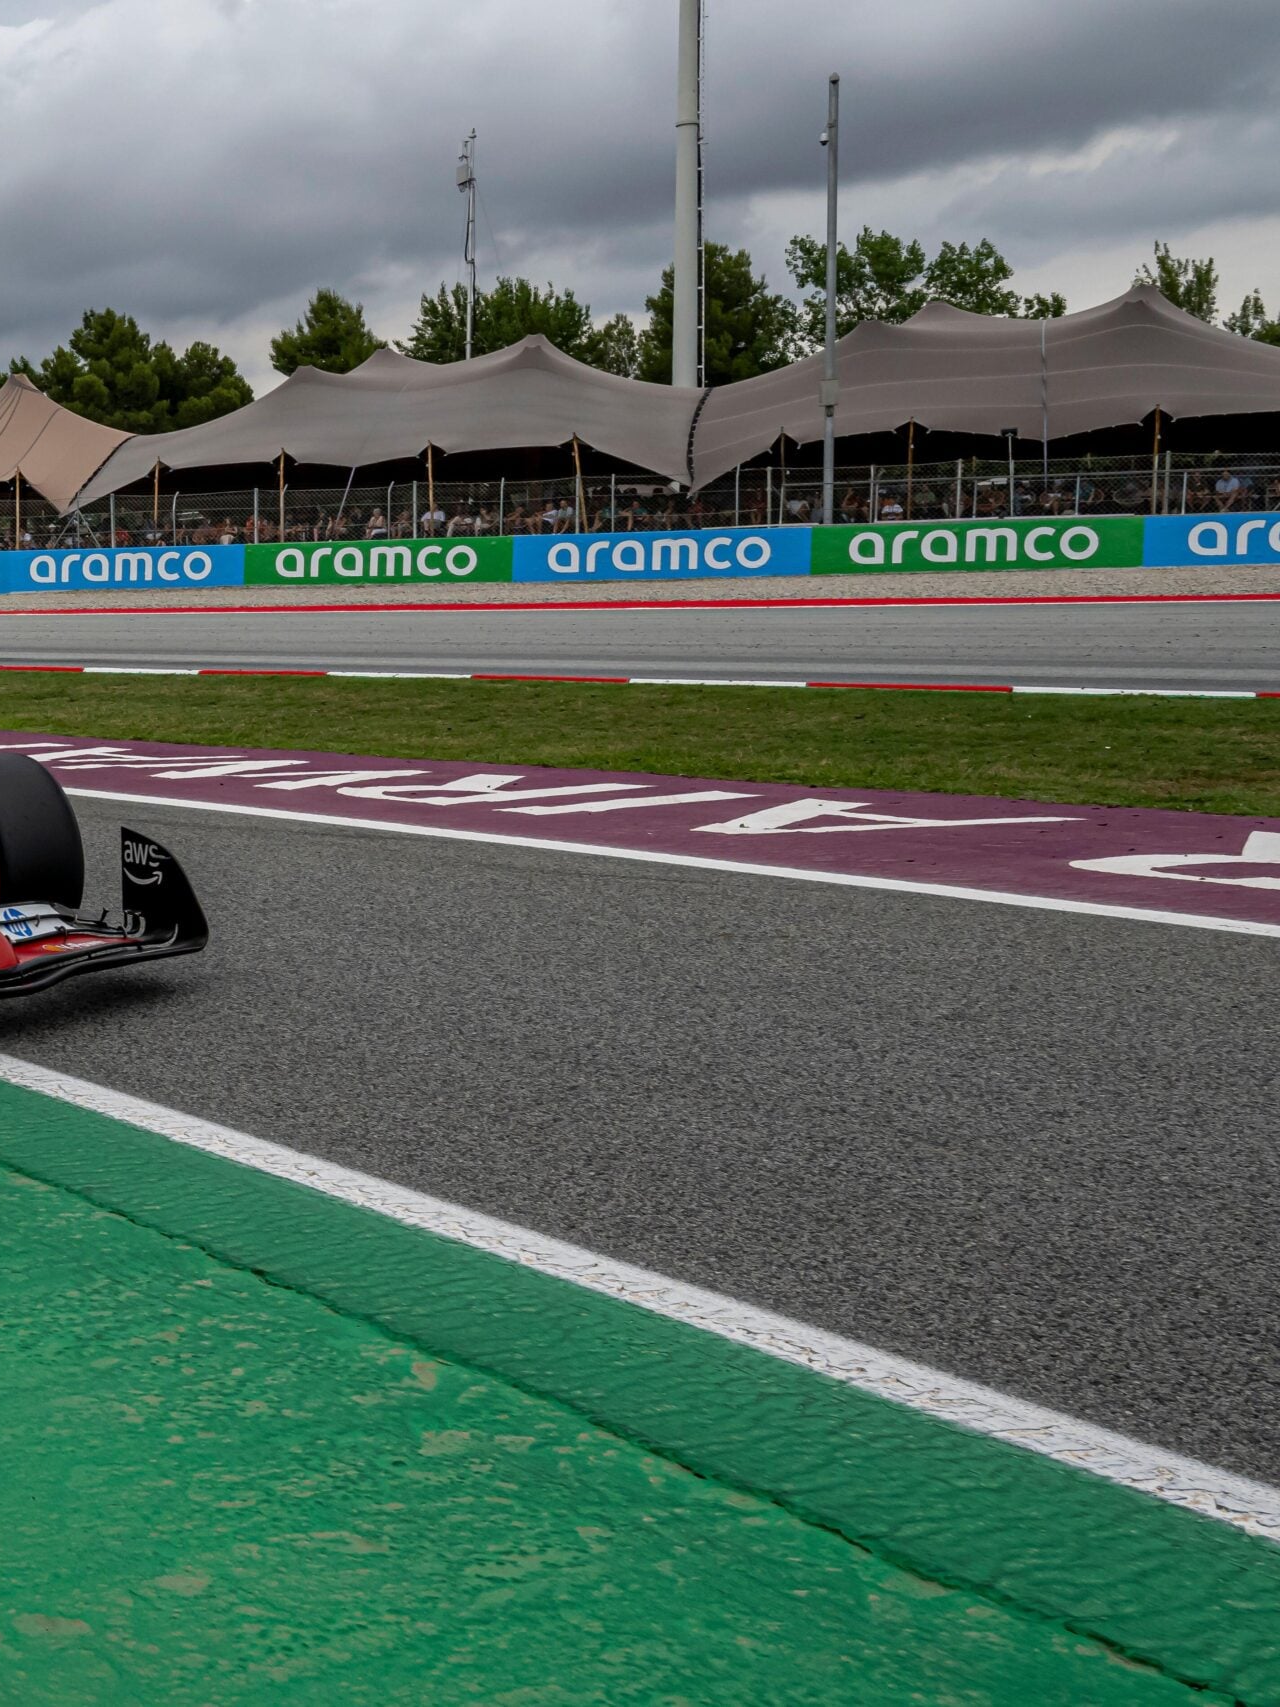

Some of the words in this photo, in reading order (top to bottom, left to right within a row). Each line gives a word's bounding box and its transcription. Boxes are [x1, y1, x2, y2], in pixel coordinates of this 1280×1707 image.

[548, 534, 772, 574] aramco
[848, 525, 1100, 565] aramco
[1187, 519, 1280, 556] ar
[29, 550, 212, 584] aramco
[275, 544, 478, 578] aramco
[124, 840, 171, 868] aws
[5, 908, 30, 937] hp
